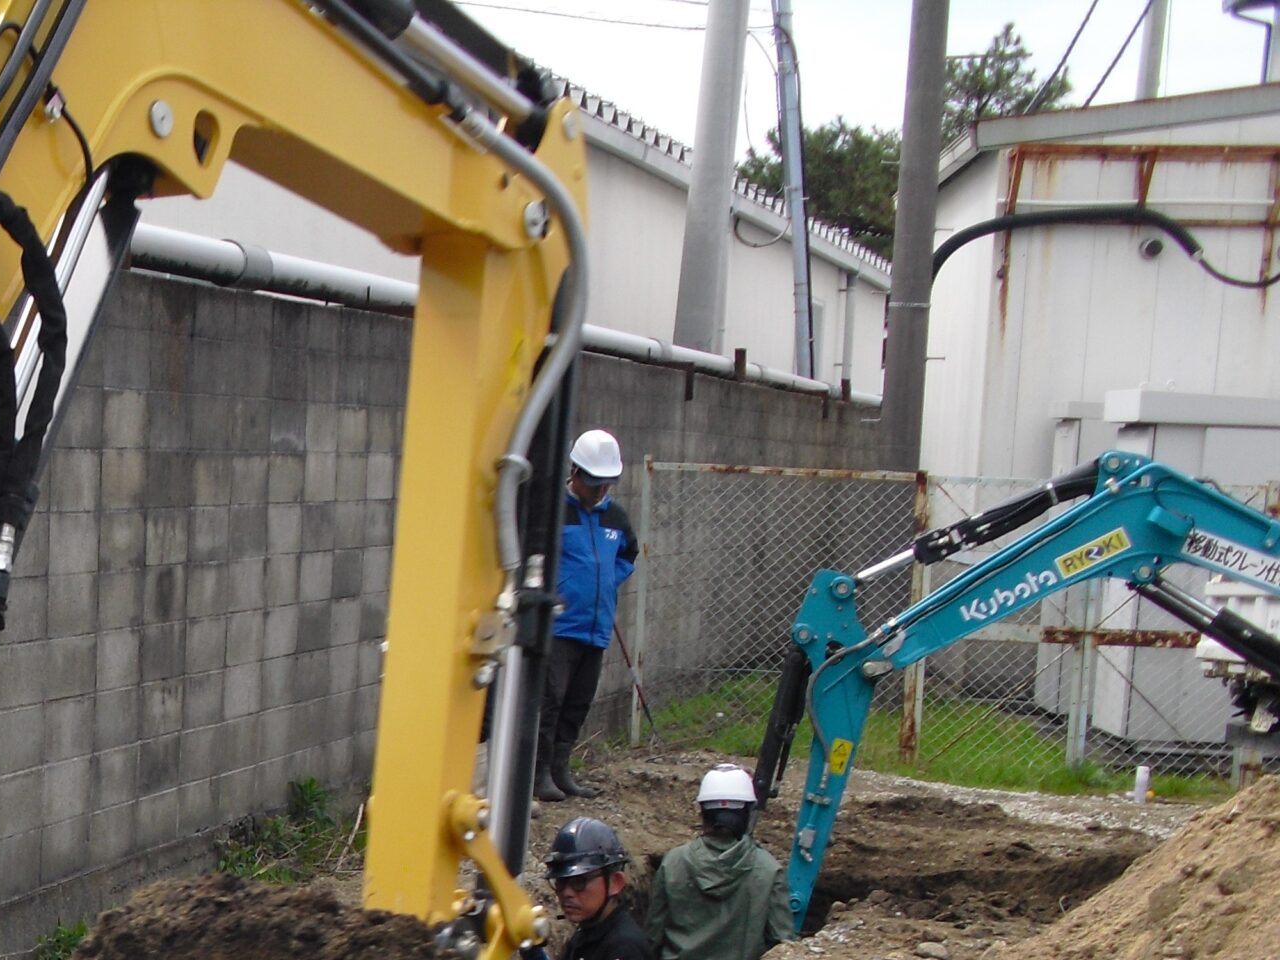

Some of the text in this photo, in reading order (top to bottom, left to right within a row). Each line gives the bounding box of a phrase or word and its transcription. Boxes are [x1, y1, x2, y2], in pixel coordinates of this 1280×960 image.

[1187, 527, 1280, 586] 移動式クレーン仕
[959, 569, 1058, 622] Kubota
